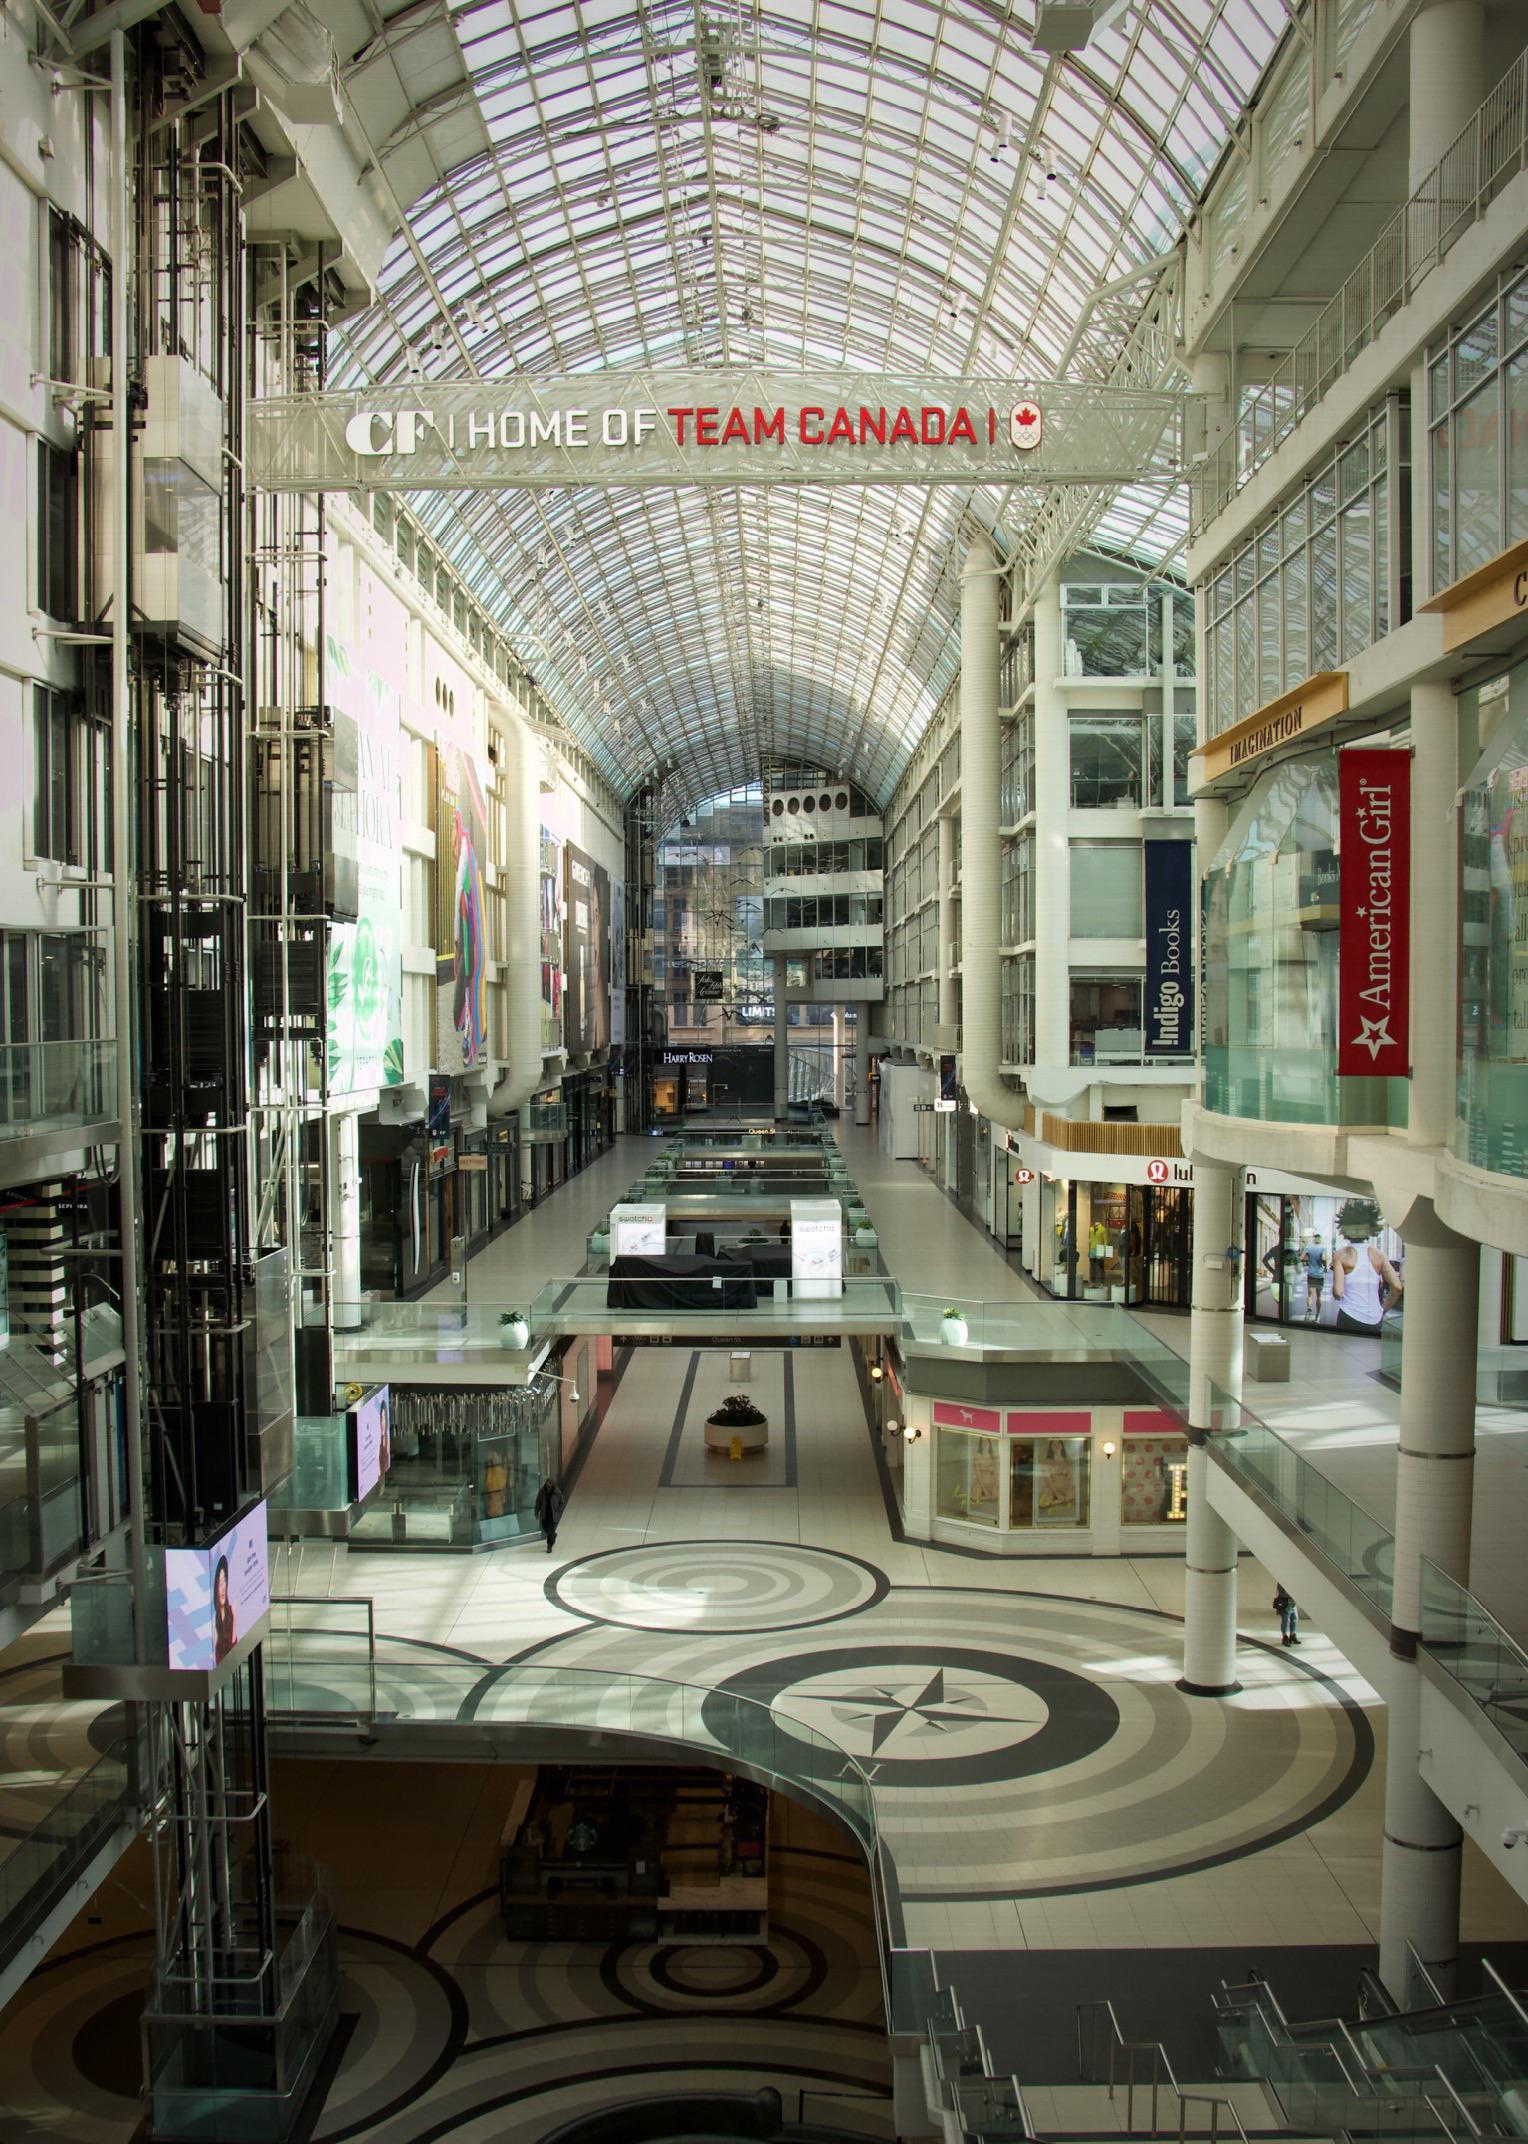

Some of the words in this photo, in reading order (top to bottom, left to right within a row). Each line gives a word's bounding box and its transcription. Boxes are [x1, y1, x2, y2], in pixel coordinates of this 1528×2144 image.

[345, 410, 434, 455] CF
[468, 409, 589, 449] HOME
[602, 408, 657, 446] OF
[667, 406, 785, 446] TEAM
[799, 405, 977, 446] CANADA
[1230, 706, 1303, 765] IMAGINATION
[1358, 784, 1392, 845] Girl
[1159, 909, 1181, 975] Books
[1358, 848, 1392, 1010] American
[663, 1052, 688, 1064] HARRY
[688, 1051, 713, 1063] ROSEN
